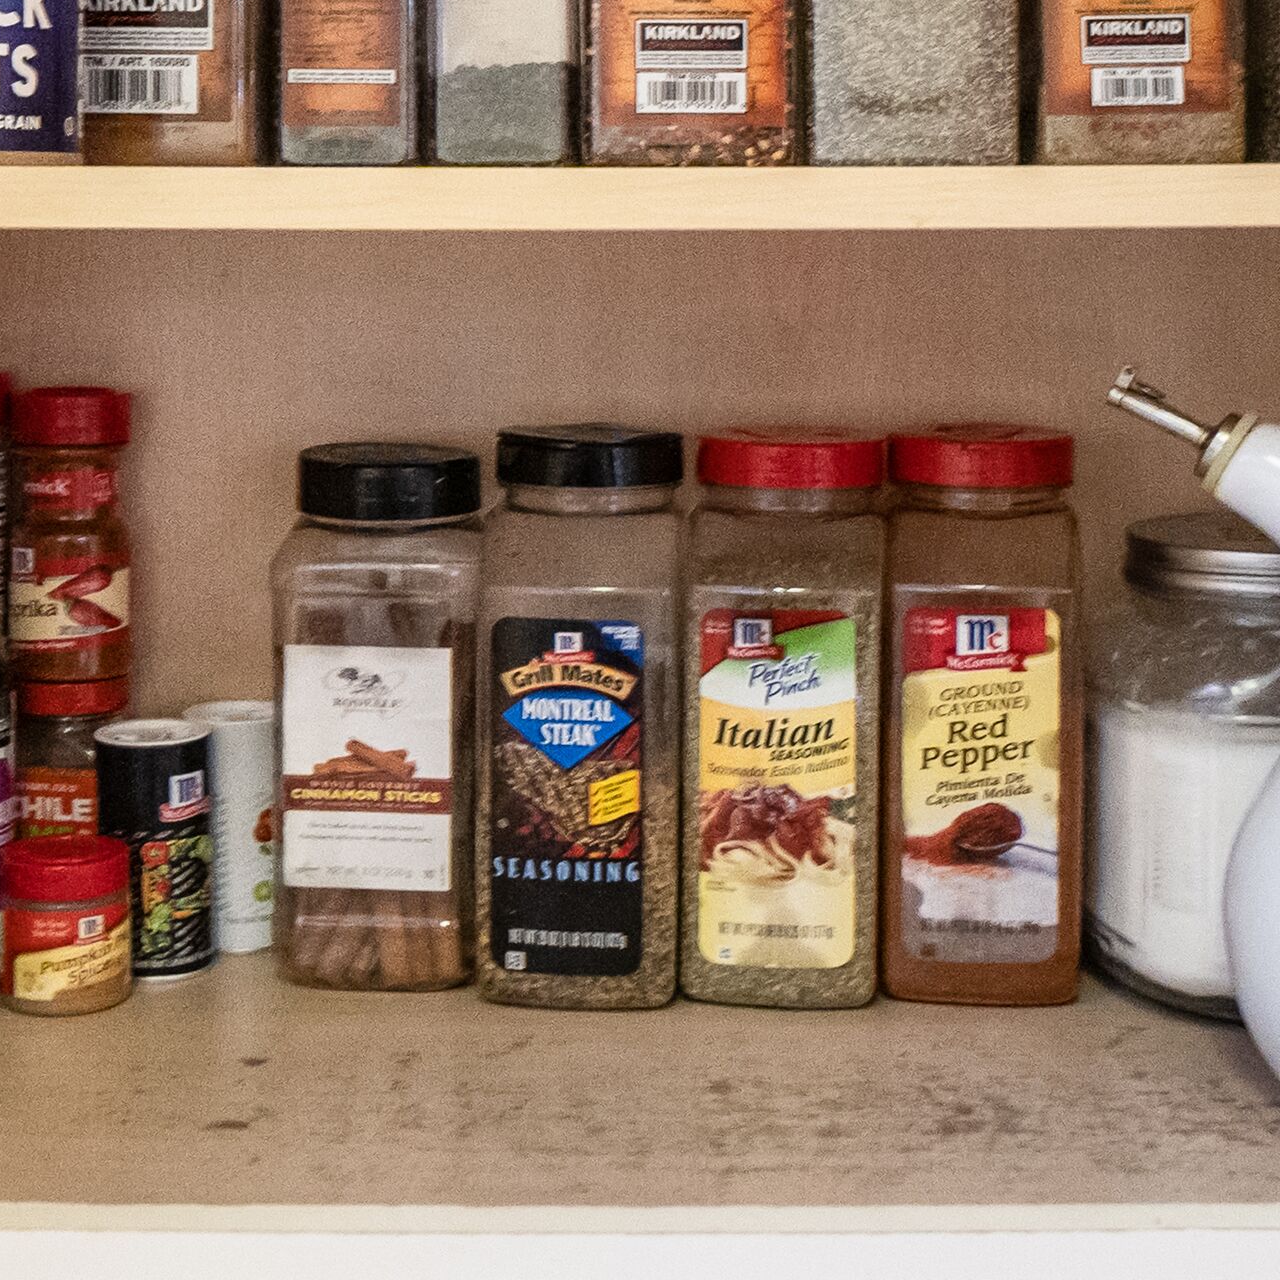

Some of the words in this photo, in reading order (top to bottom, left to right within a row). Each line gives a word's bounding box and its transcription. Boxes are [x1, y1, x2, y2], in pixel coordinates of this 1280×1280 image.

[644, 24, 741, 41] KIRKLAND
[1089, 20, 1184, 37] KIRKLAND
[748, 652, 819, 688] Perfect
[945, 653, 1018, 670] McCormick
[511, 663, 554, 688] Grill
[560, 664, 624, 692] Mates
[763, 670, 821, 705] Pinch
[939, 681, 1024, 702] GROUND
[521, 697, 616, 722] MONTREAL
[928, 695, 1031, 720] (CAYENNE)
[540, 722, 599, 747] STEAK
[713, 717, 836, 749] Italian
[946, 713, 1009, 744] Red
[768, 737, 849, 762] SEASONING
[920, 739, 1036, 775] Pepper
[290, 787, 381, 802] CINNAMON
[383, 789, 442, 804] STICKS
[925, 791, 979, 809] Cayena
[12, 796, 96, 823] HILE
[492, 855, 641, 883] SEASONING
